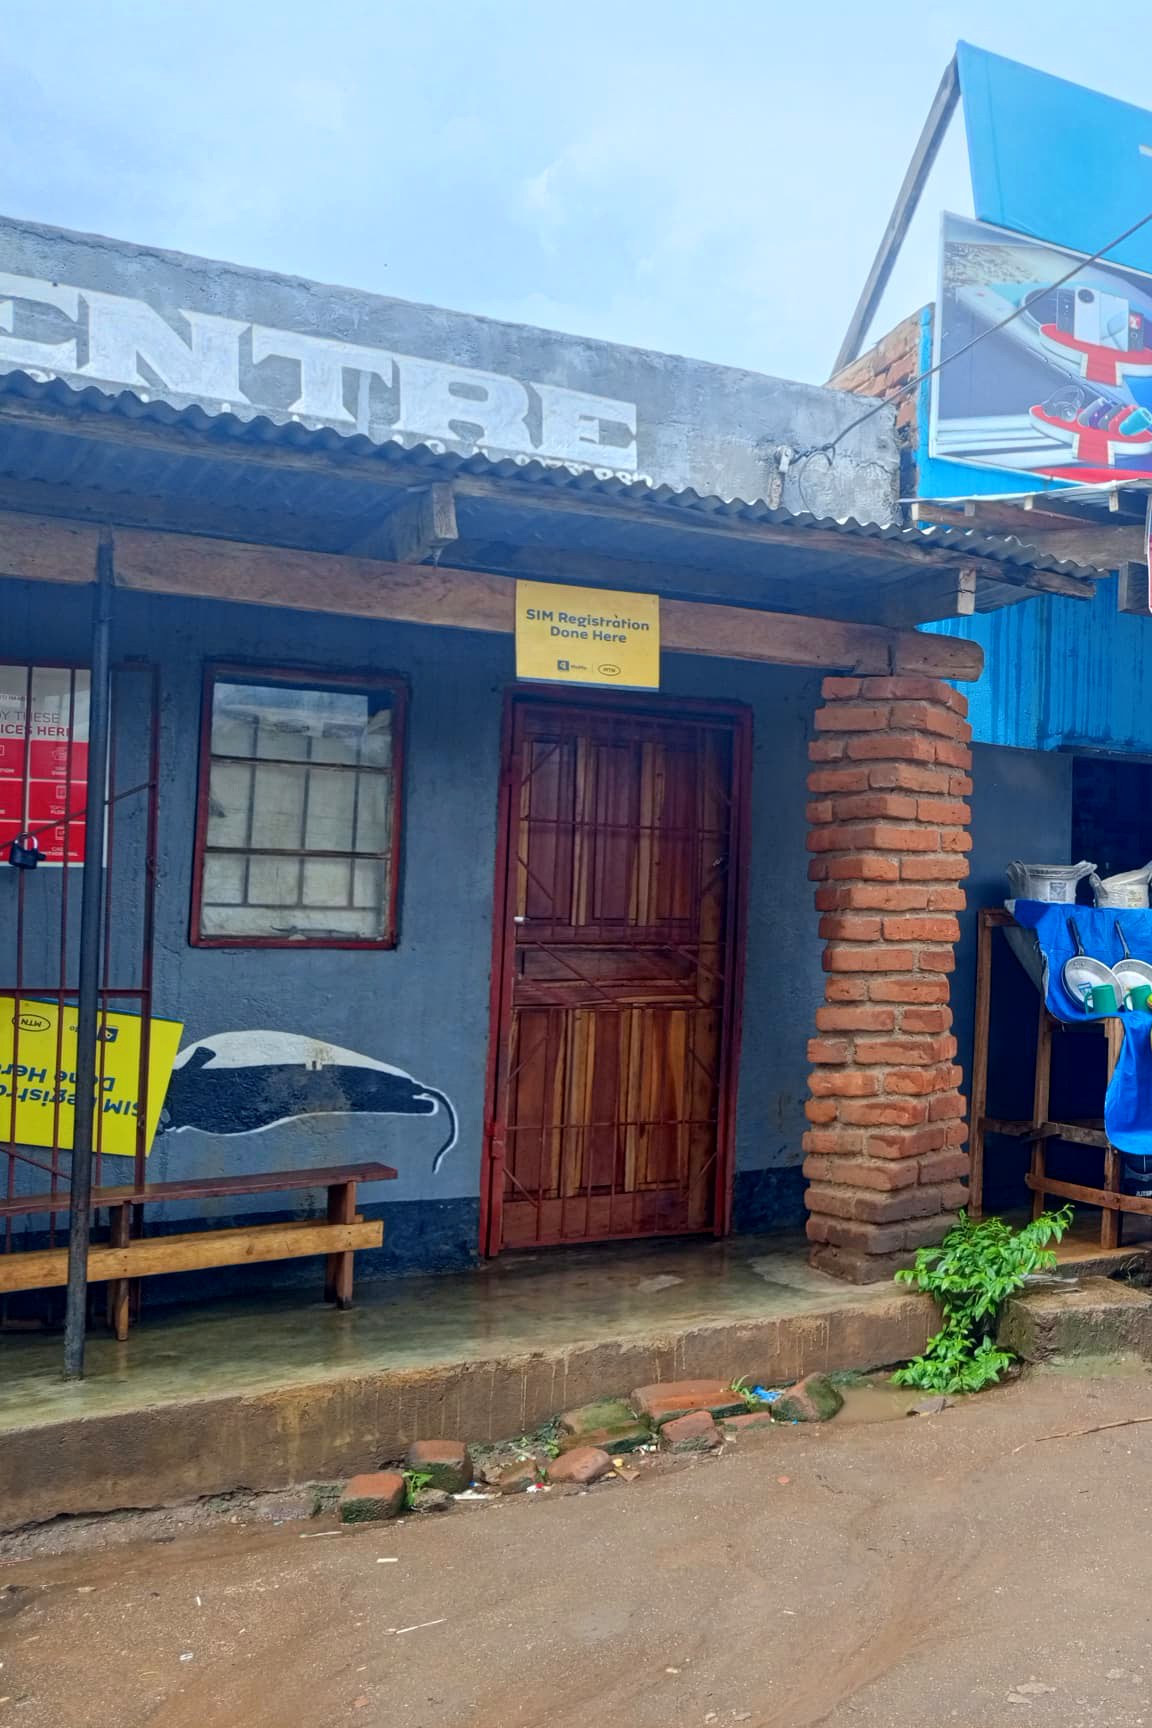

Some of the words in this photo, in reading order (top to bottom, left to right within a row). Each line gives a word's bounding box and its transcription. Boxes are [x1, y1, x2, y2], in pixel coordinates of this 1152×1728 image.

[526, 608, 554, 622] SIM
[558, 611, 650, 631] Registration
[550, 625, 588, 640] Done
[592, 630, 627, 644] Here
[37, 726, 70, 737] HER
[21, 1018, 42, 1028] MTN
[0, 1063, 47, 1083] Her
[55, 1067, 115, 1092] Dne
[103, 1098, 138, 1117] SIM
